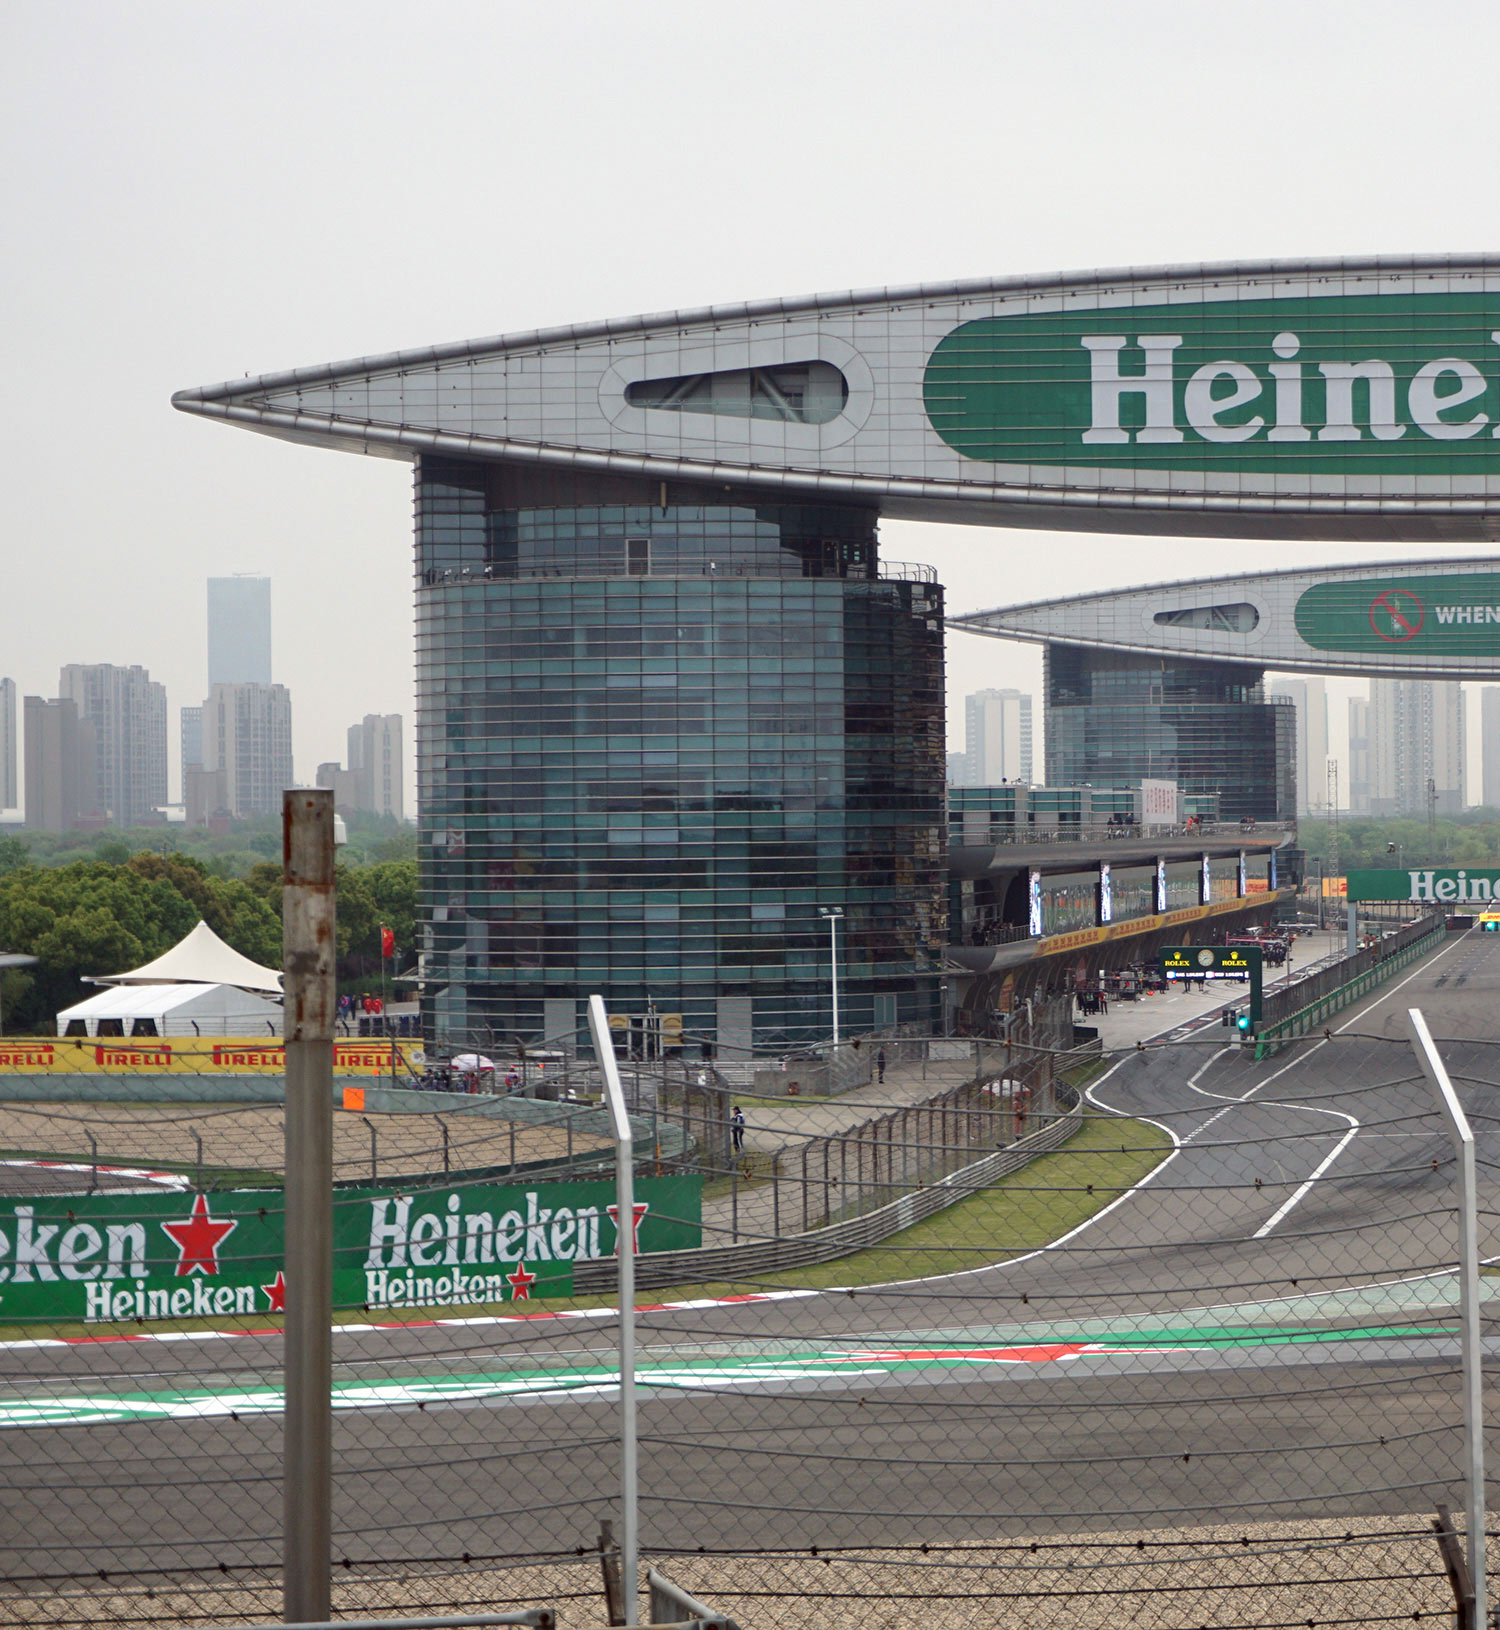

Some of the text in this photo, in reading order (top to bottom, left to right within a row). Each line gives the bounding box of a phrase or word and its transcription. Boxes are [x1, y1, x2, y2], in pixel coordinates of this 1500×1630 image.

[1435, 606, 1500, 624] WHEN
[0, 1045, 54, 1066] RELLI
[95, 1045, 172, 1066] PIRELLI
[363, 1192, 601, 1269] Heineken
[83, 1277, 257, 1324] Heineken
[365, 1267, 503, 1310] Heineken
